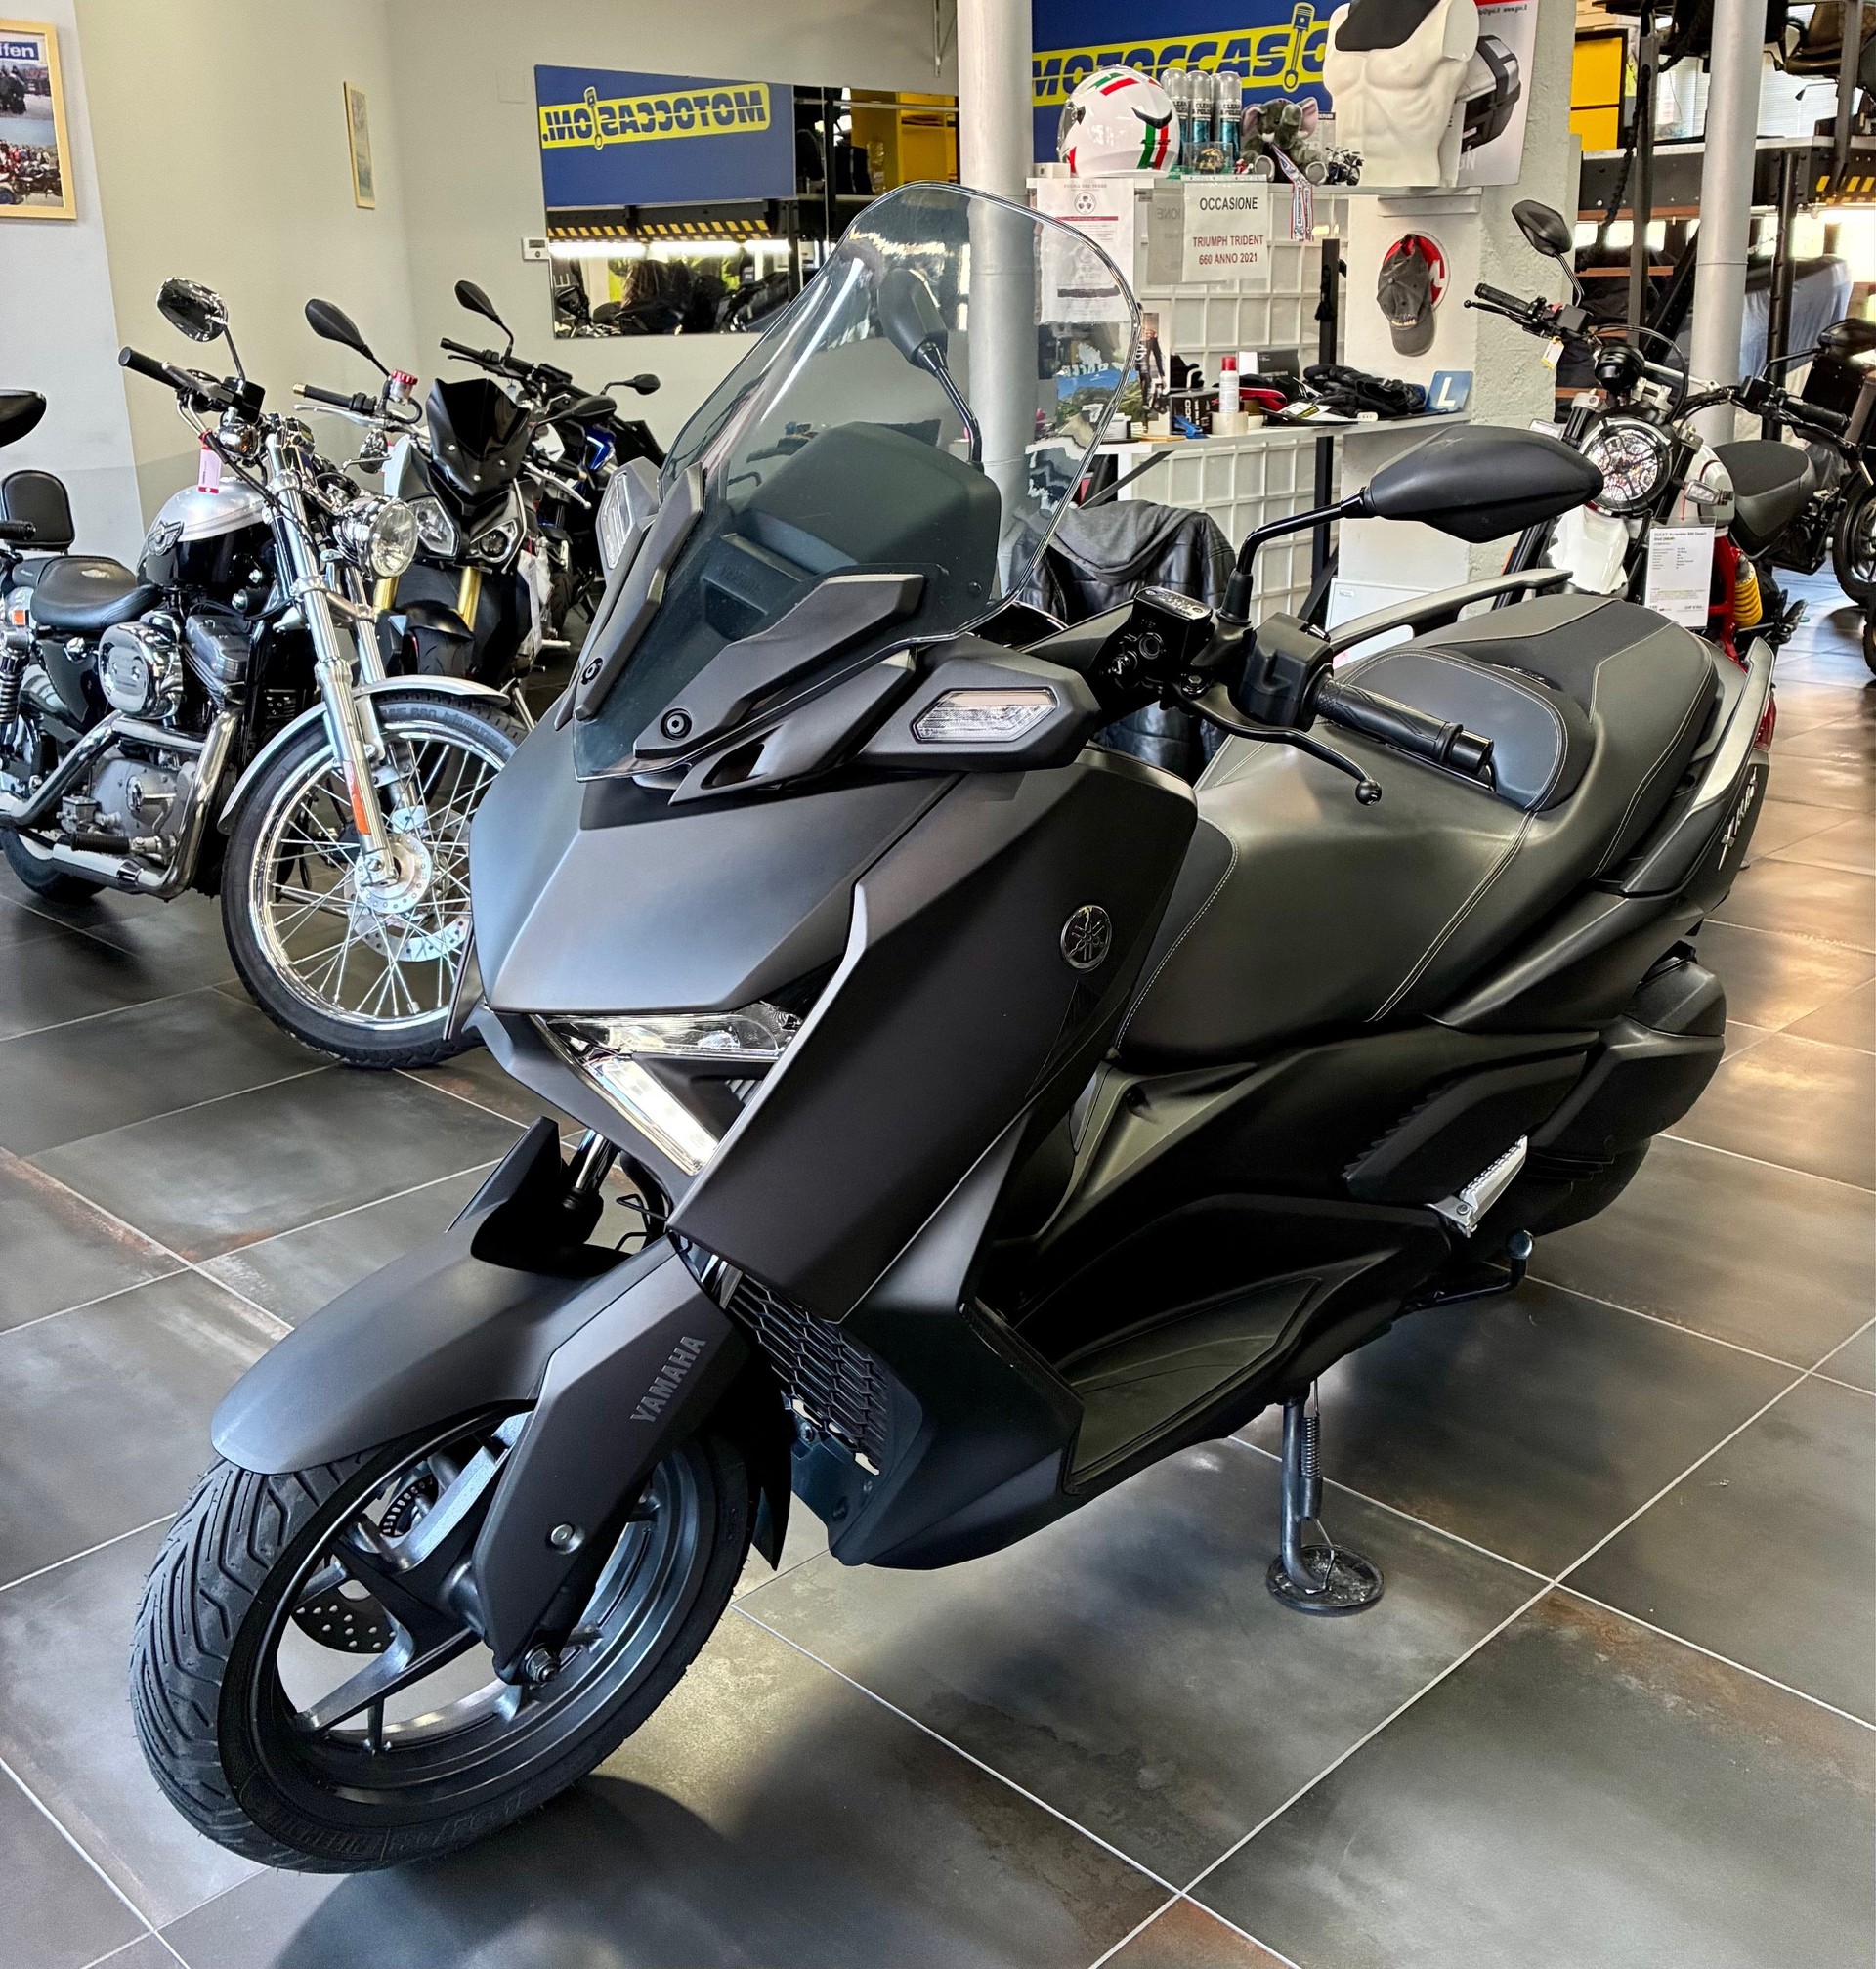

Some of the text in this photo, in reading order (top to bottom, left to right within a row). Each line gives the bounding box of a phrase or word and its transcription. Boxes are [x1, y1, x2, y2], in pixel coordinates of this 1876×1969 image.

[1199, 196, 1258, 211] OCCASIONE
[1192, 235, 1264, 247] TRIUMPH TRIDENT
[1198, 252, 1258, 265] 660 ANNO 2021
[1435, 377, 1457, 409] L
[629, 1336, 706, 1423] YAMAHA
